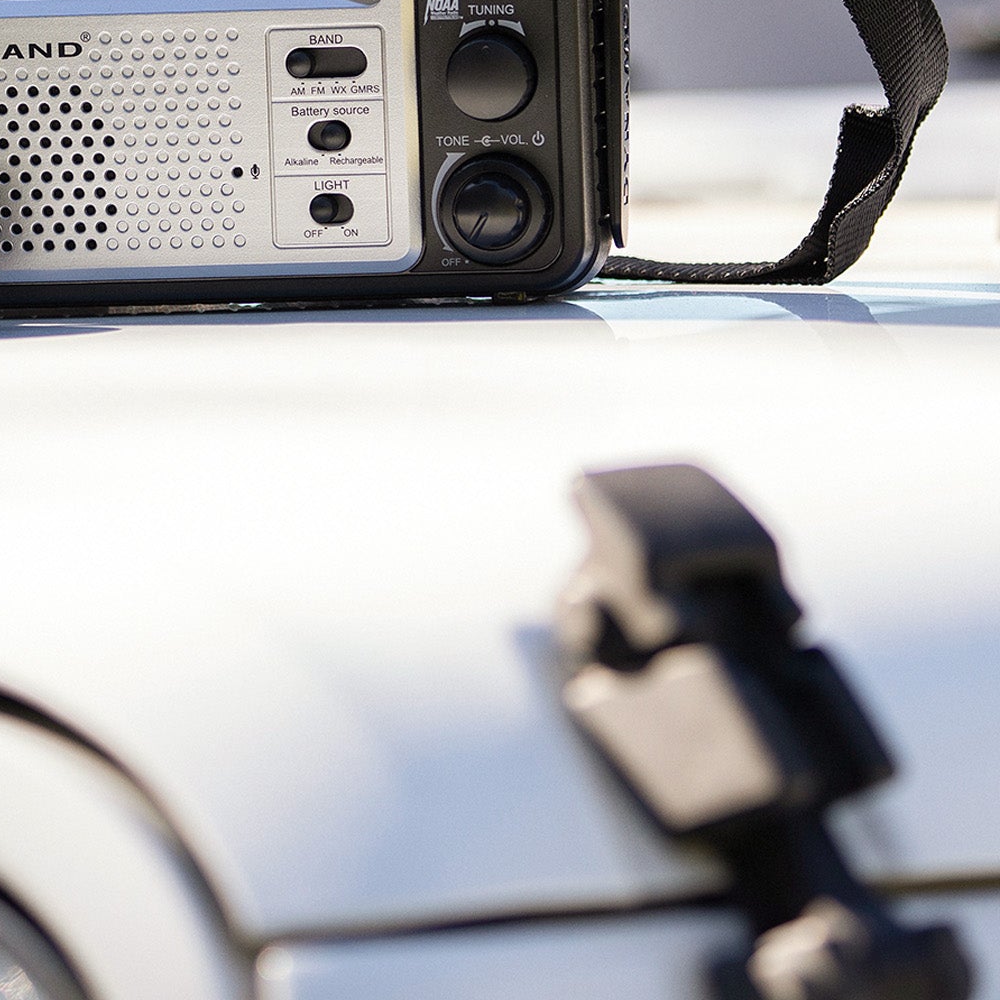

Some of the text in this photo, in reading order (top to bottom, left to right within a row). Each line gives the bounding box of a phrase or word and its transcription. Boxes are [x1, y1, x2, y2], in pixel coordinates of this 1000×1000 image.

[468, 4, 515, 16] TUNING
[309, 34, 344, 46] BAND
[290, 84, 381, 96] AM FM WX GMRS
[291, 105, 370, 118] Battery source
[435, 134, 470, 147] TONE
[284, 157, 319, 166] Alkaline
[329, 156, 384, 167] Rechargeable
[314, 179, 350, 191] LIGHT
[303, 229, 324, 239] OFF
[343, 228, 359, 238] ON
[441, 257, 461, 267] OFF
